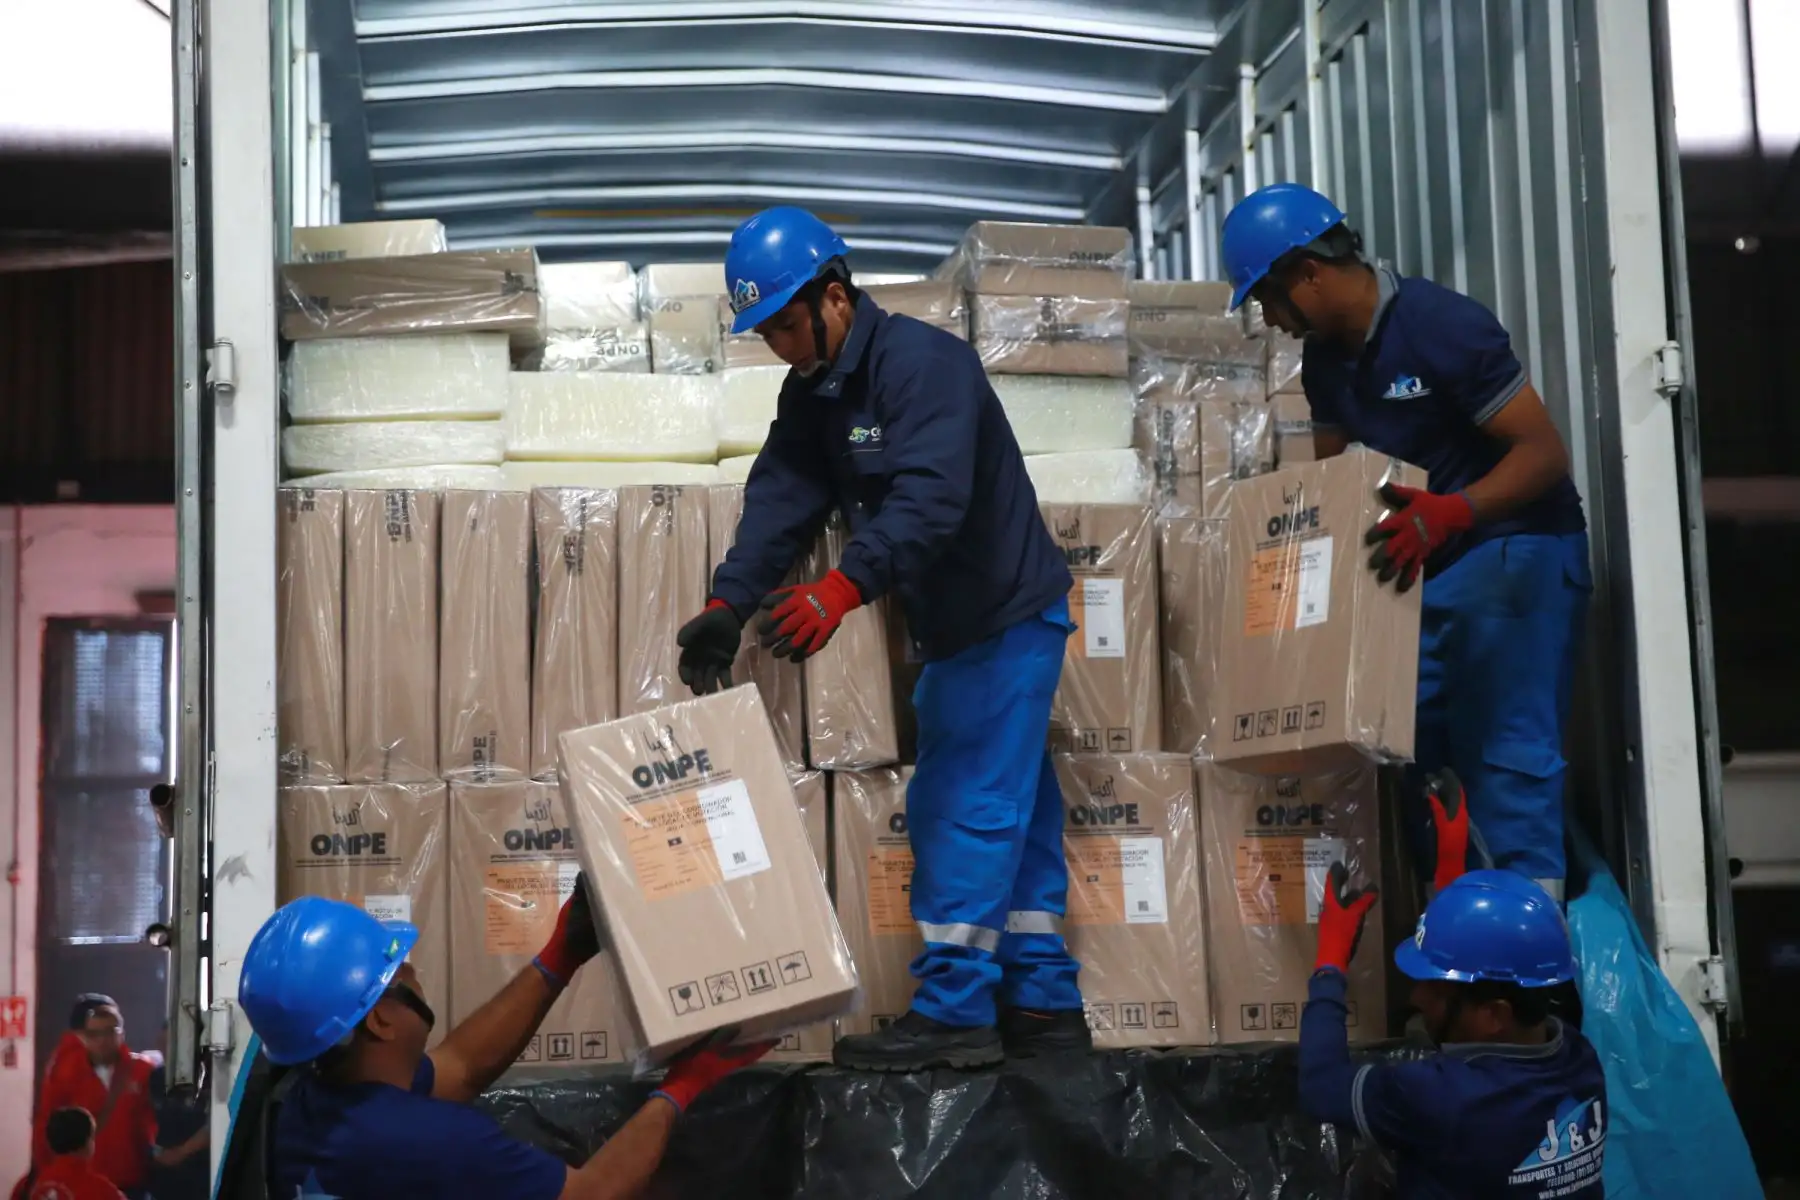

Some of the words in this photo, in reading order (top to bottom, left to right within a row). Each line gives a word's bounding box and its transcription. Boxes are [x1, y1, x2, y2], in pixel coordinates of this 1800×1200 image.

[1267, 506, 1321, 538] ONPE
[1062, 546, 1102, 566] NPE
[631, 748, 714, 789] ONPE
[1070, 803, 1140, 826] ONPE
[1256, 803, 1324, 826] ONPE
[310, 832, 387, 856] ONPE
[1508, 1166, 1556, 1185] TRANSPORTES
[1557, 1163, 1562, 1174] Y
